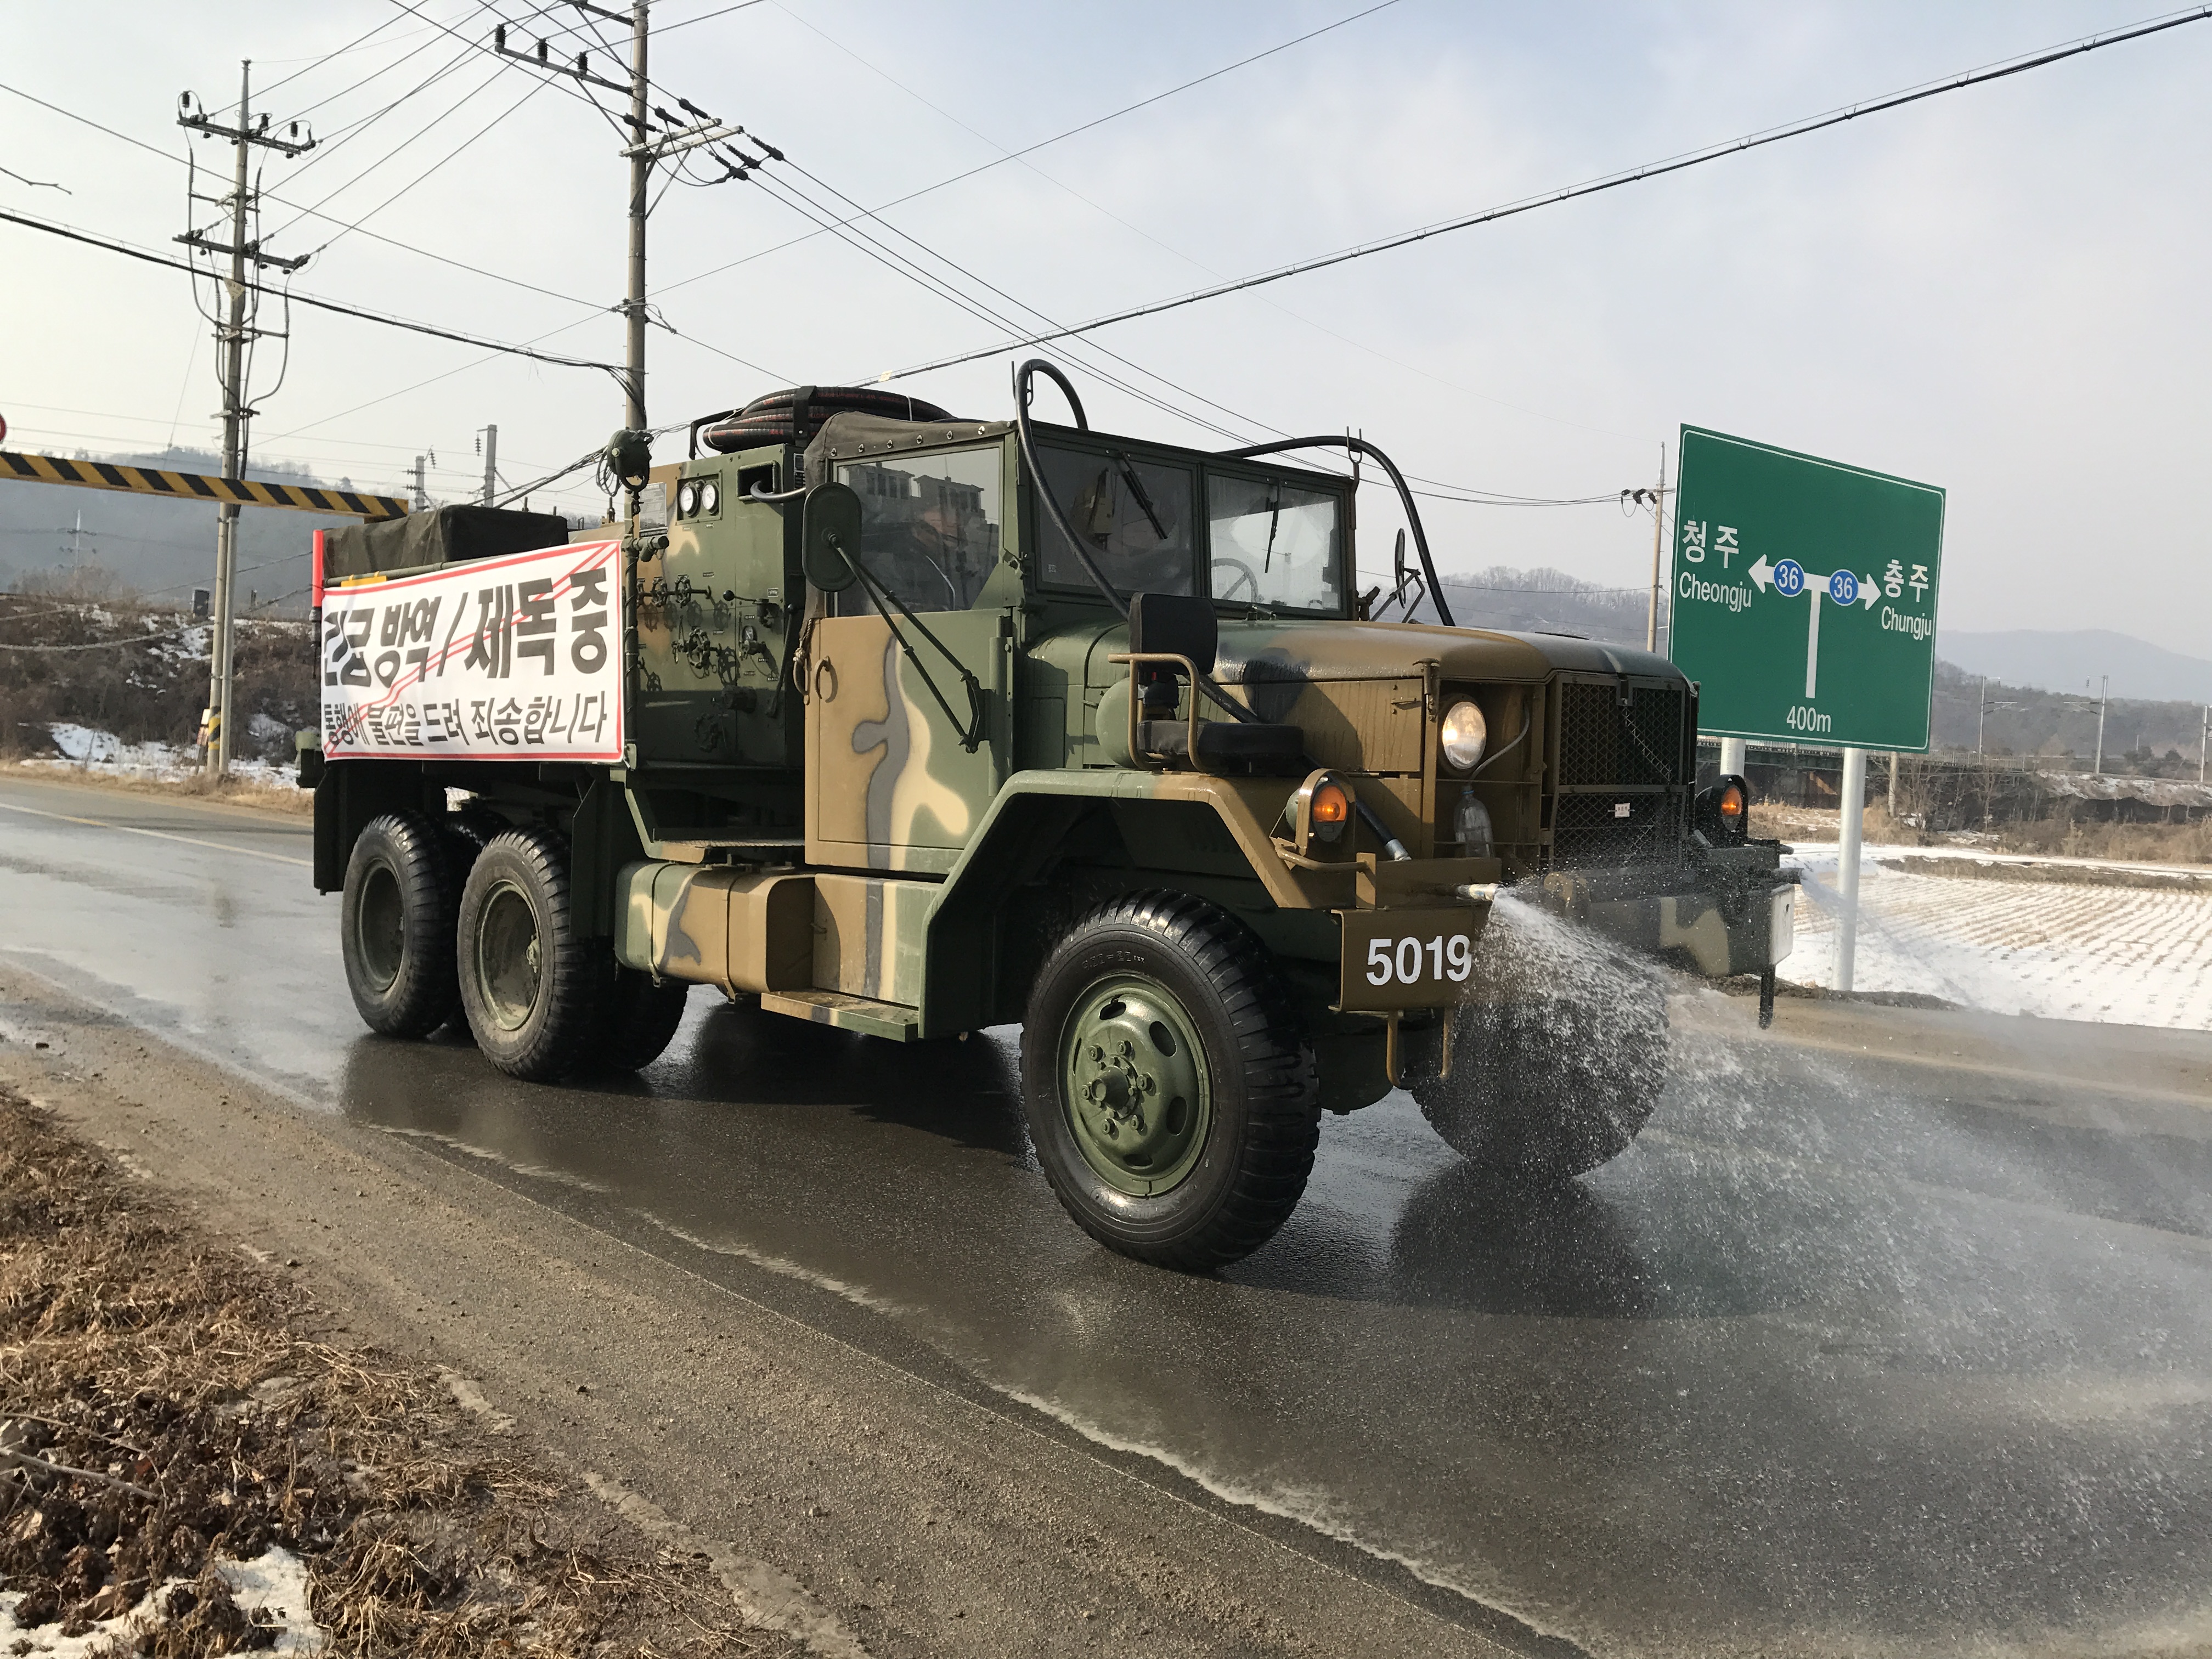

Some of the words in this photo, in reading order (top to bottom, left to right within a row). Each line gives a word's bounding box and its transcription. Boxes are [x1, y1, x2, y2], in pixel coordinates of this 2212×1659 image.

[1682, 520, 1739, 568] 청주
[1679, 572, 1752, 613] Cheongju
[1778, 565, 1799, 590] 36
[1834, 575, 1853, 599] 36
[1883, 559, 1929, 603] 충주
[1881, 606, 1932, 641] Chungju
[366, 703, 424, 746] 불편을
[423, 698, 470, 746] 드려
[471, 690, 607, 745] 죄송합니다
[1786, 706, 1831, 732] 400m
[1366, 934, 1472, 986] 5019
